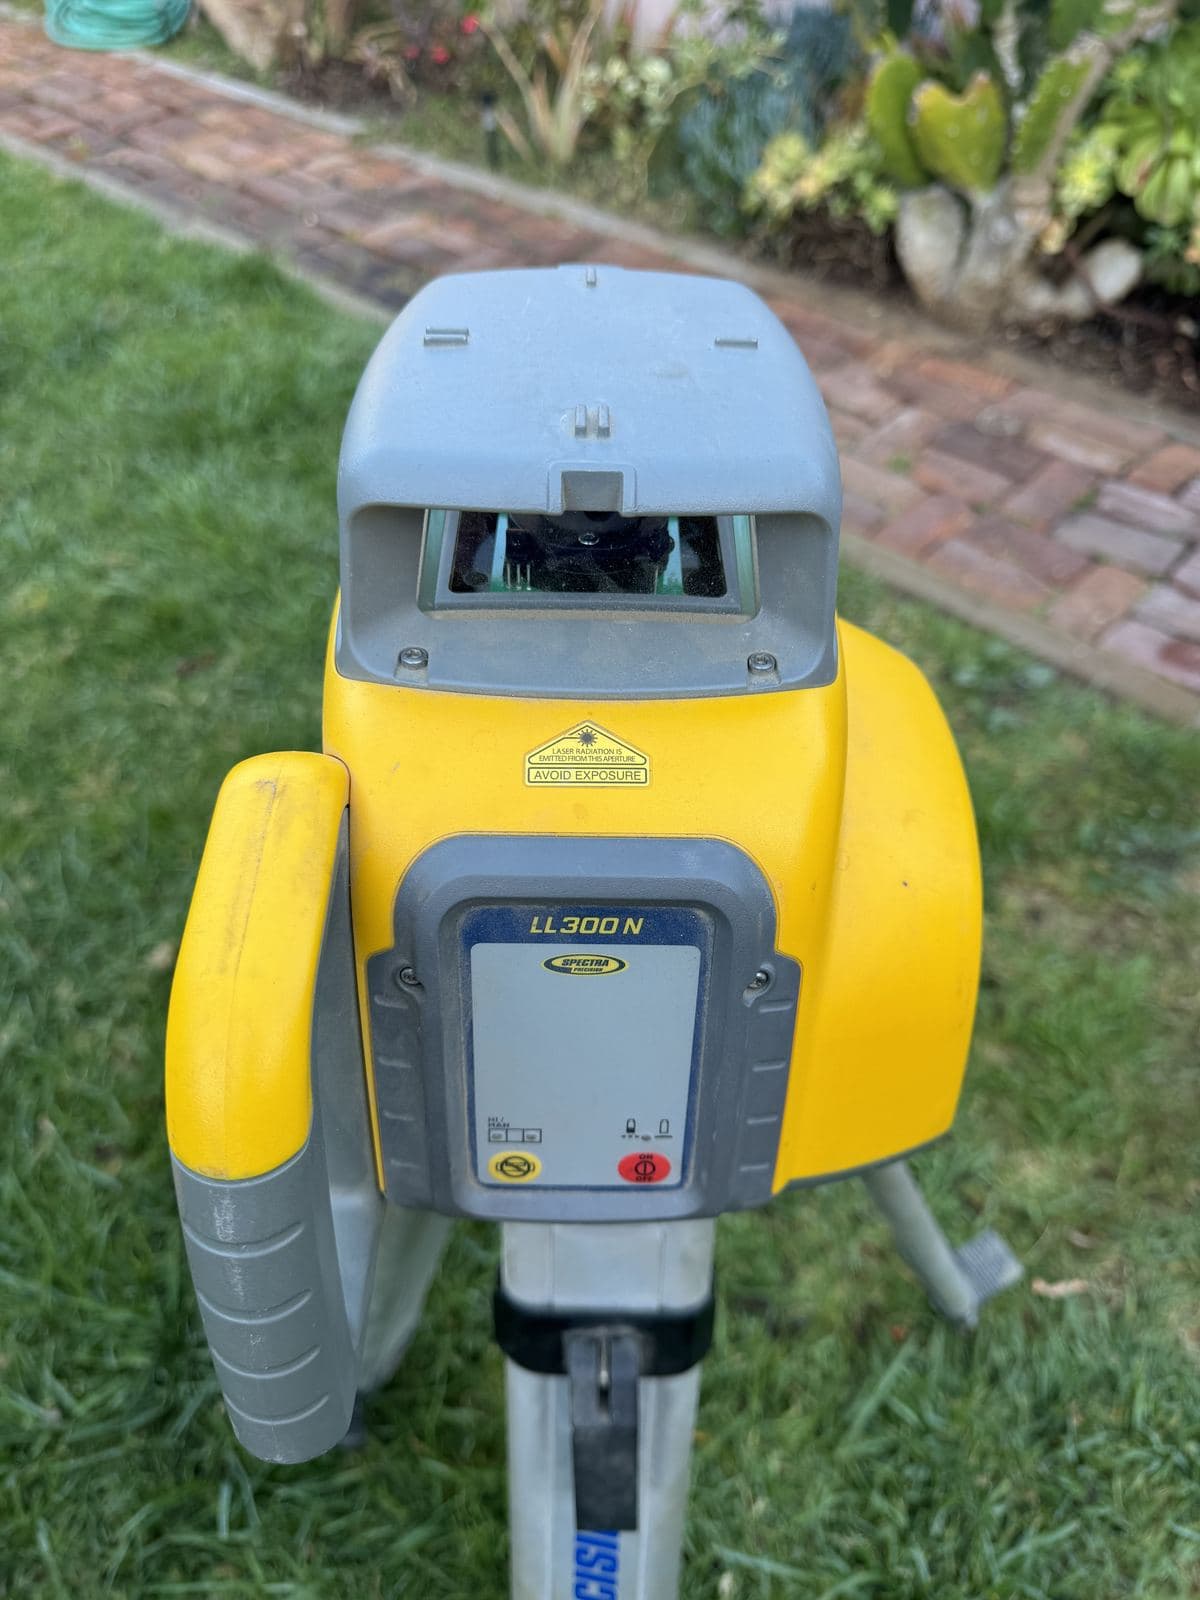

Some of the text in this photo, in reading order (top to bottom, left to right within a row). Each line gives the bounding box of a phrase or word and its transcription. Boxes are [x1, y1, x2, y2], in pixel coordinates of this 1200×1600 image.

[539, 755, 636, 763] EMITTED FROM THIS APERTURE
[534, 770, 641, 781] AVOID EXPOSURE
[530, 916, 644, 935] LL300 N
[561, 958, 610, 967] SPECTRA
